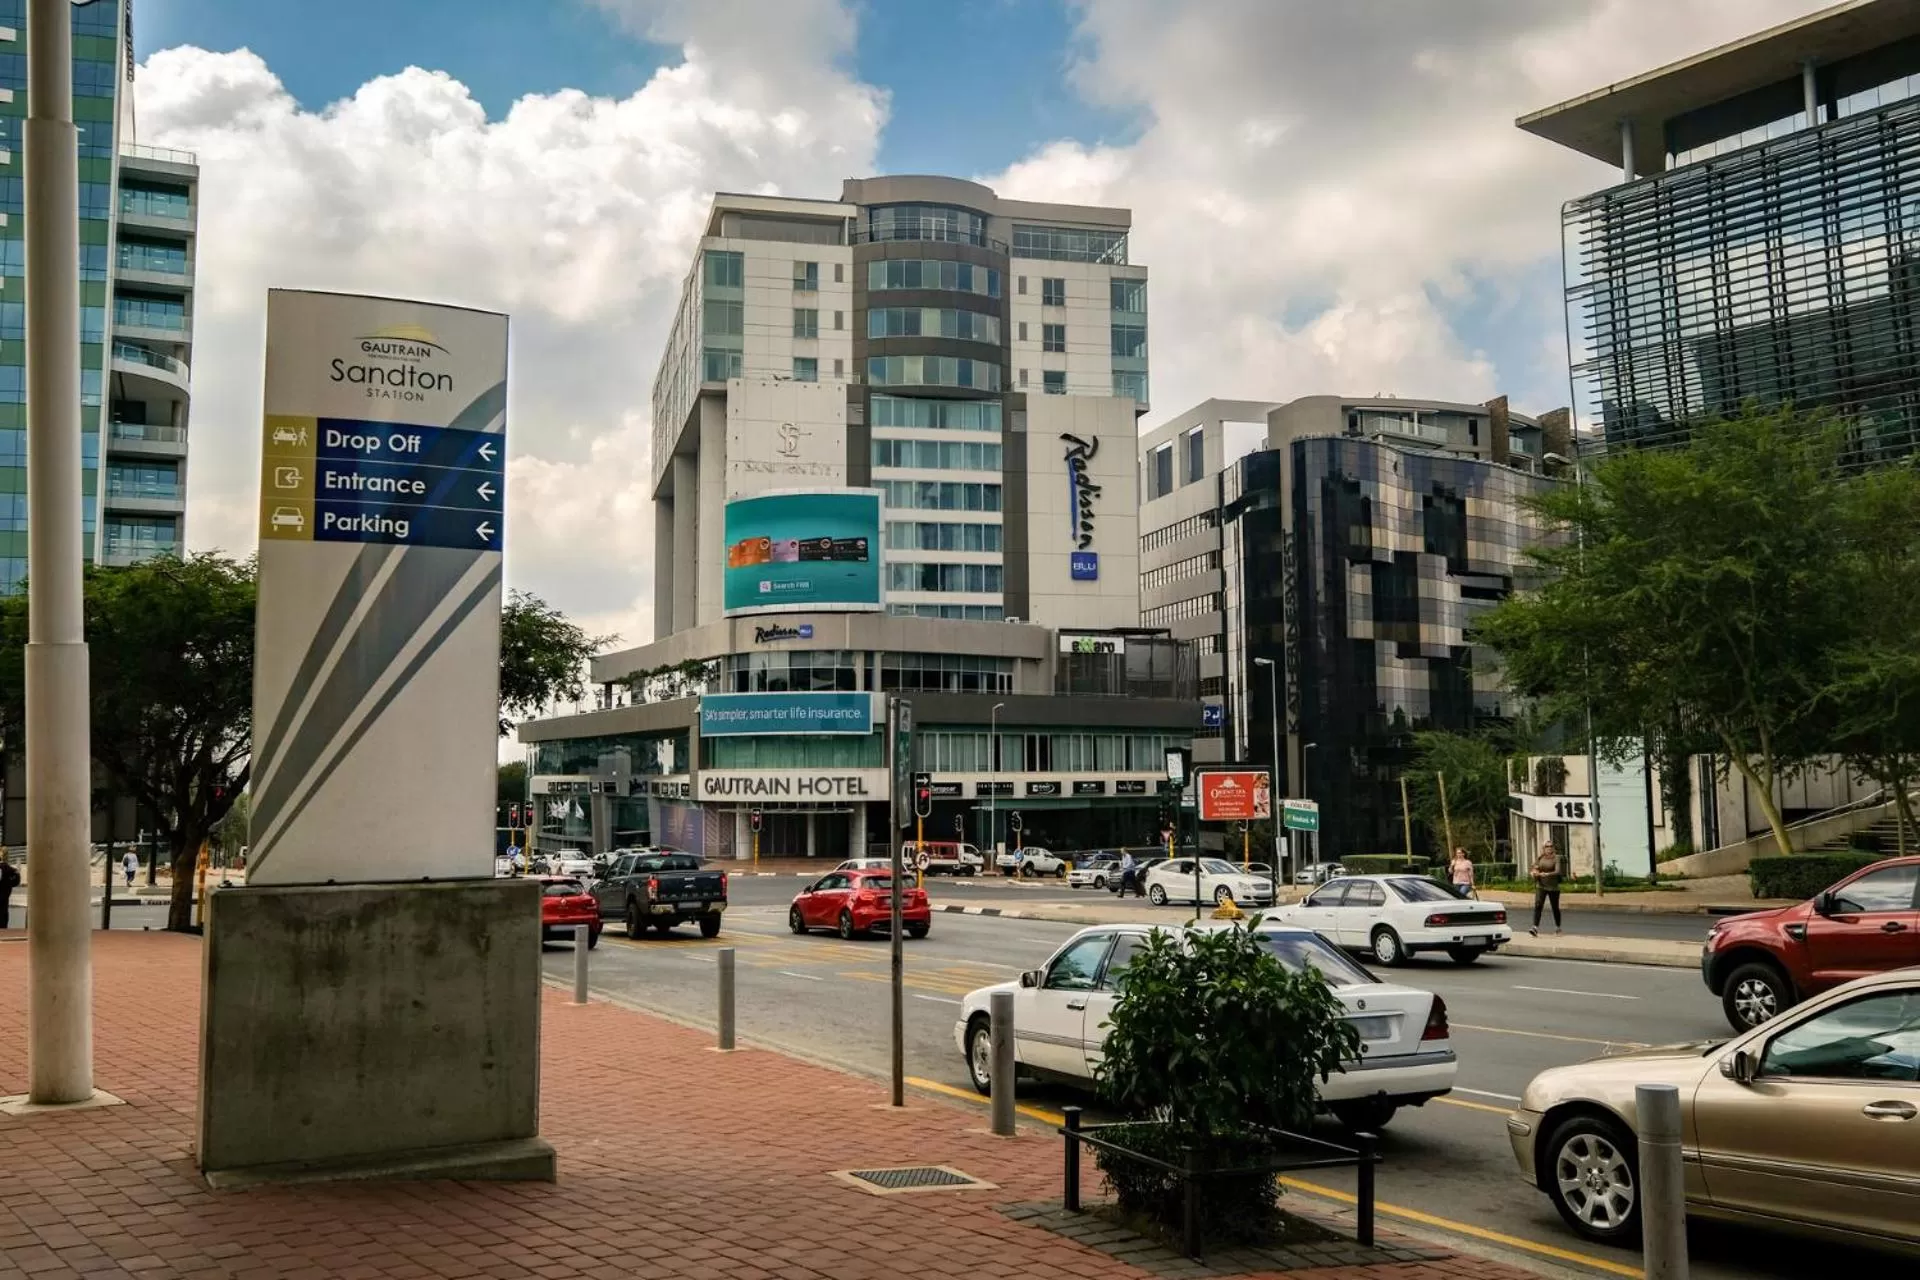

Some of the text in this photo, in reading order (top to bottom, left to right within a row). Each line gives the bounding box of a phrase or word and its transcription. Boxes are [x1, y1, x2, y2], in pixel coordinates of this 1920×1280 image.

[361, 341, 431, 358] GAUTRAIN
[330, 358, 453, 392] Sandton
[366, 388, 425, 402] STATION
[326, 429, 422, 454] Drop Off
[324, 470, 426, 494] Entrance
[1059, 432, 1103, 550] Radisson
[323, 511, 410, 537] Parking
[1073, 561, 1097, 572] BLU
[773, 581, 795, 590] Search
[755, 624, 801, 643] Radisson
[718, 708, 749, 722] simpler,
[749, 708, 787, 720] smarter
[790, 706, 807, 719] life
[808, 707, 862, 719] insurance.
[1203, 710, 1211, 720] P
[704, 777, 791, 796] GAUTRAIN
[797, 776, 869, 795] HOTEL
[1555, 802, 1585, 818] 115
